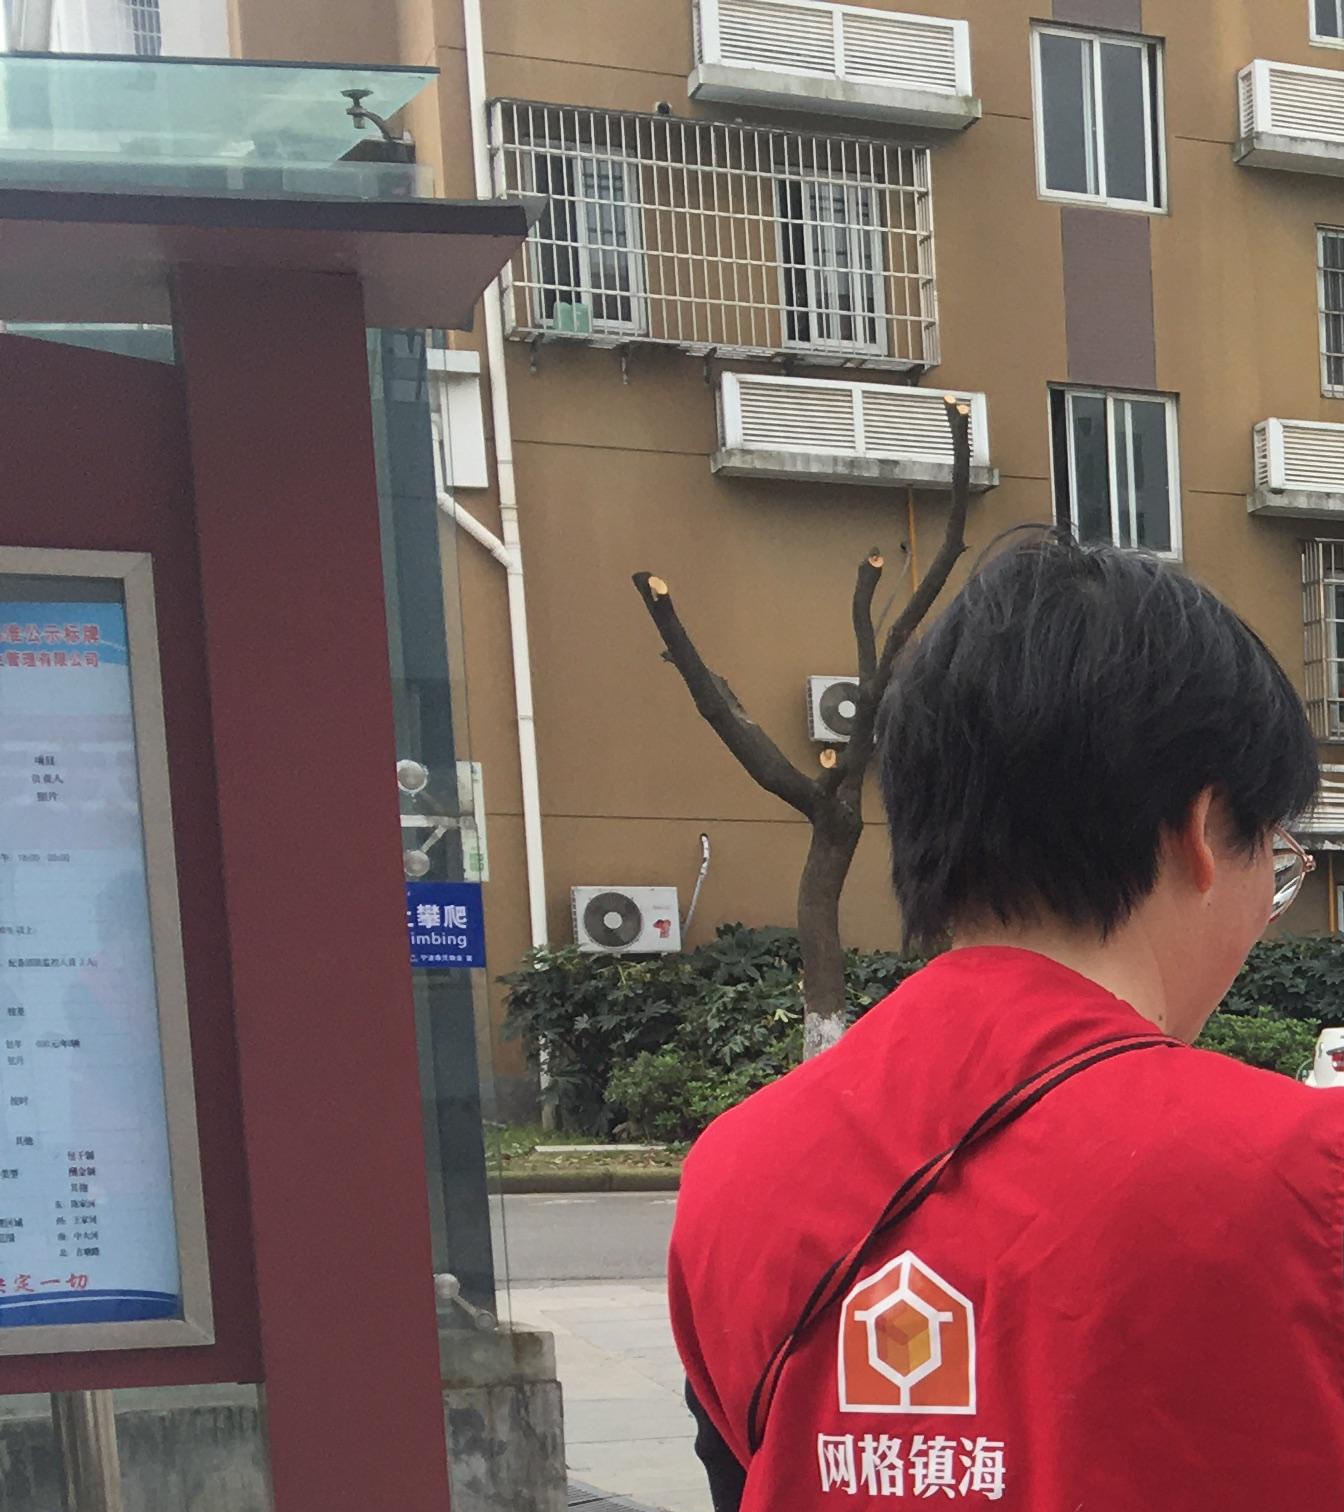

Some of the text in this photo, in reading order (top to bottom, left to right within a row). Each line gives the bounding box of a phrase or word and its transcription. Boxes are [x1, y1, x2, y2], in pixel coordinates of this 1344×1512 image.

[0, 622, 100, 645] 准公示标牌
[410, 931, 468, 949] imbing
[816, 1433, 1006, 1500] 网格镇海
